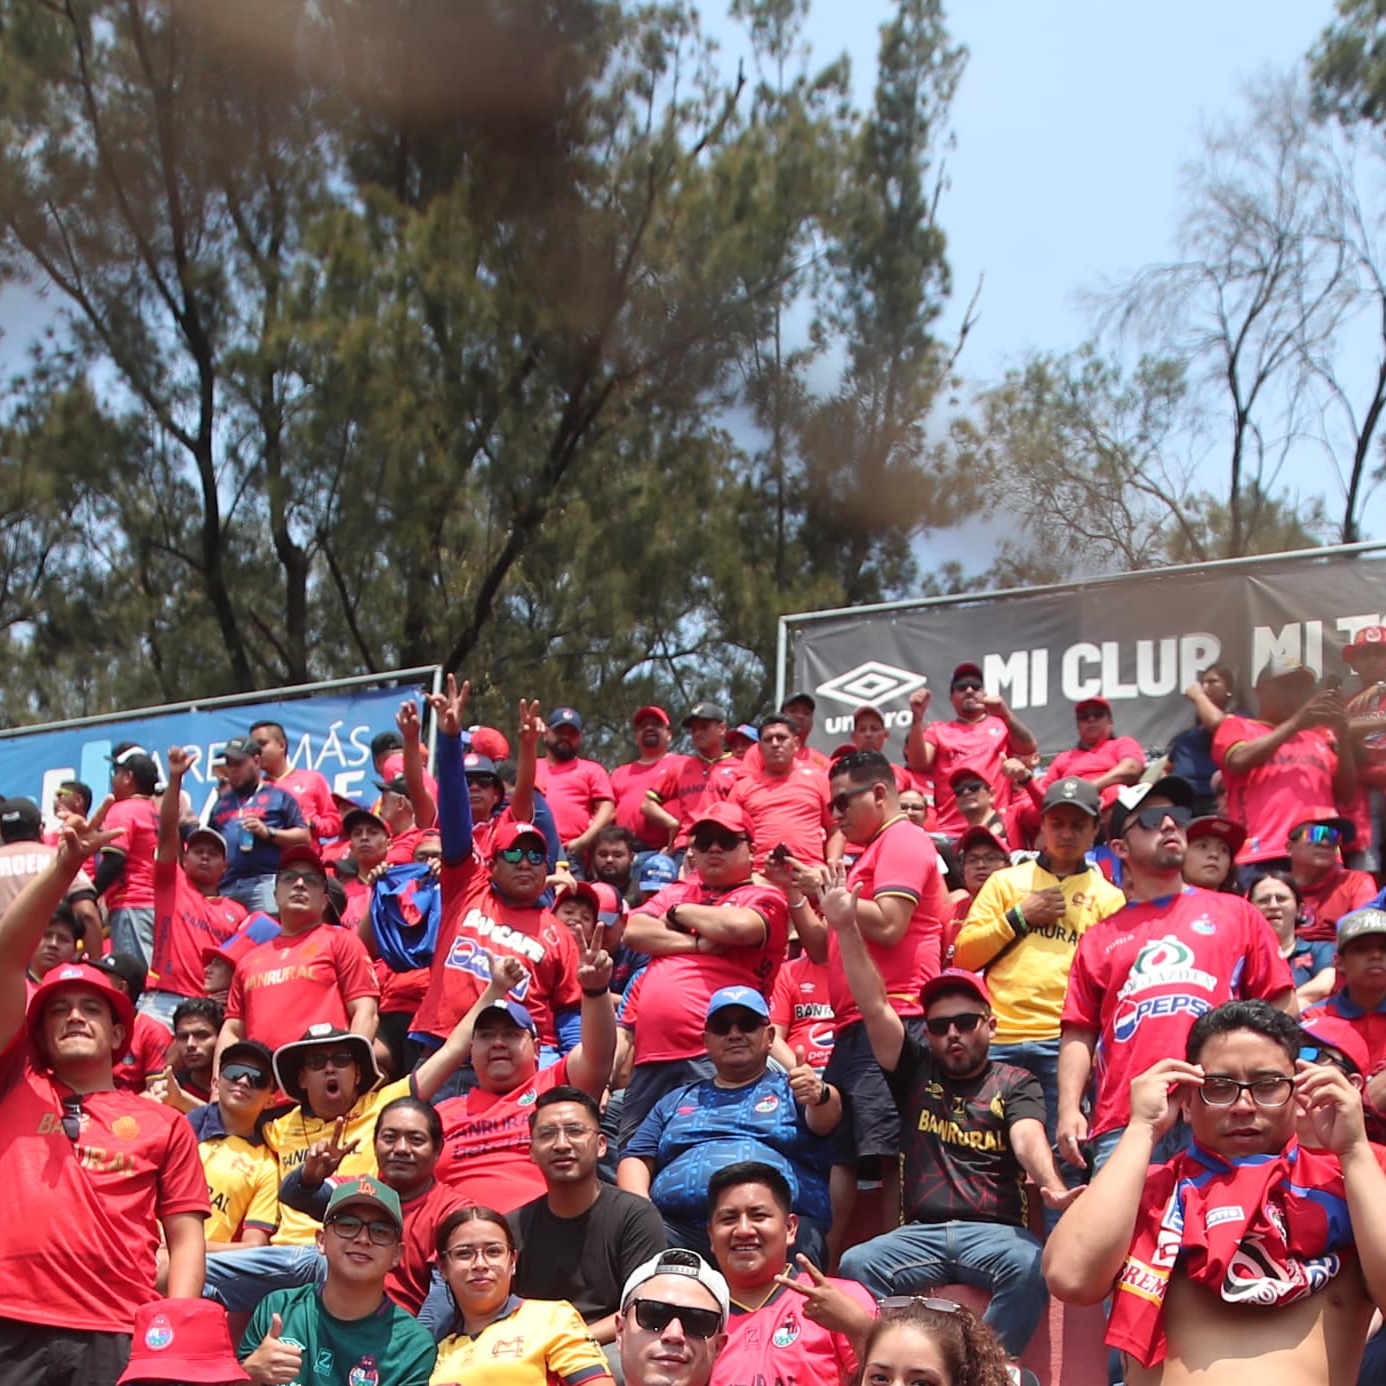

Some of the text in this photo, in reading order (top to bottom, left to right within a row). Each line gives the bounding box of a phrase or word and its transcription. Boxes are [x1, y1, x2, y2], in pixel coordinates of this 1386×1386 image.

[984, 630, 1224, 710] MI CLUB
[918, 1108, 1007, 1152] BANRURAL
[356, 1179, 377, 1196] LA
